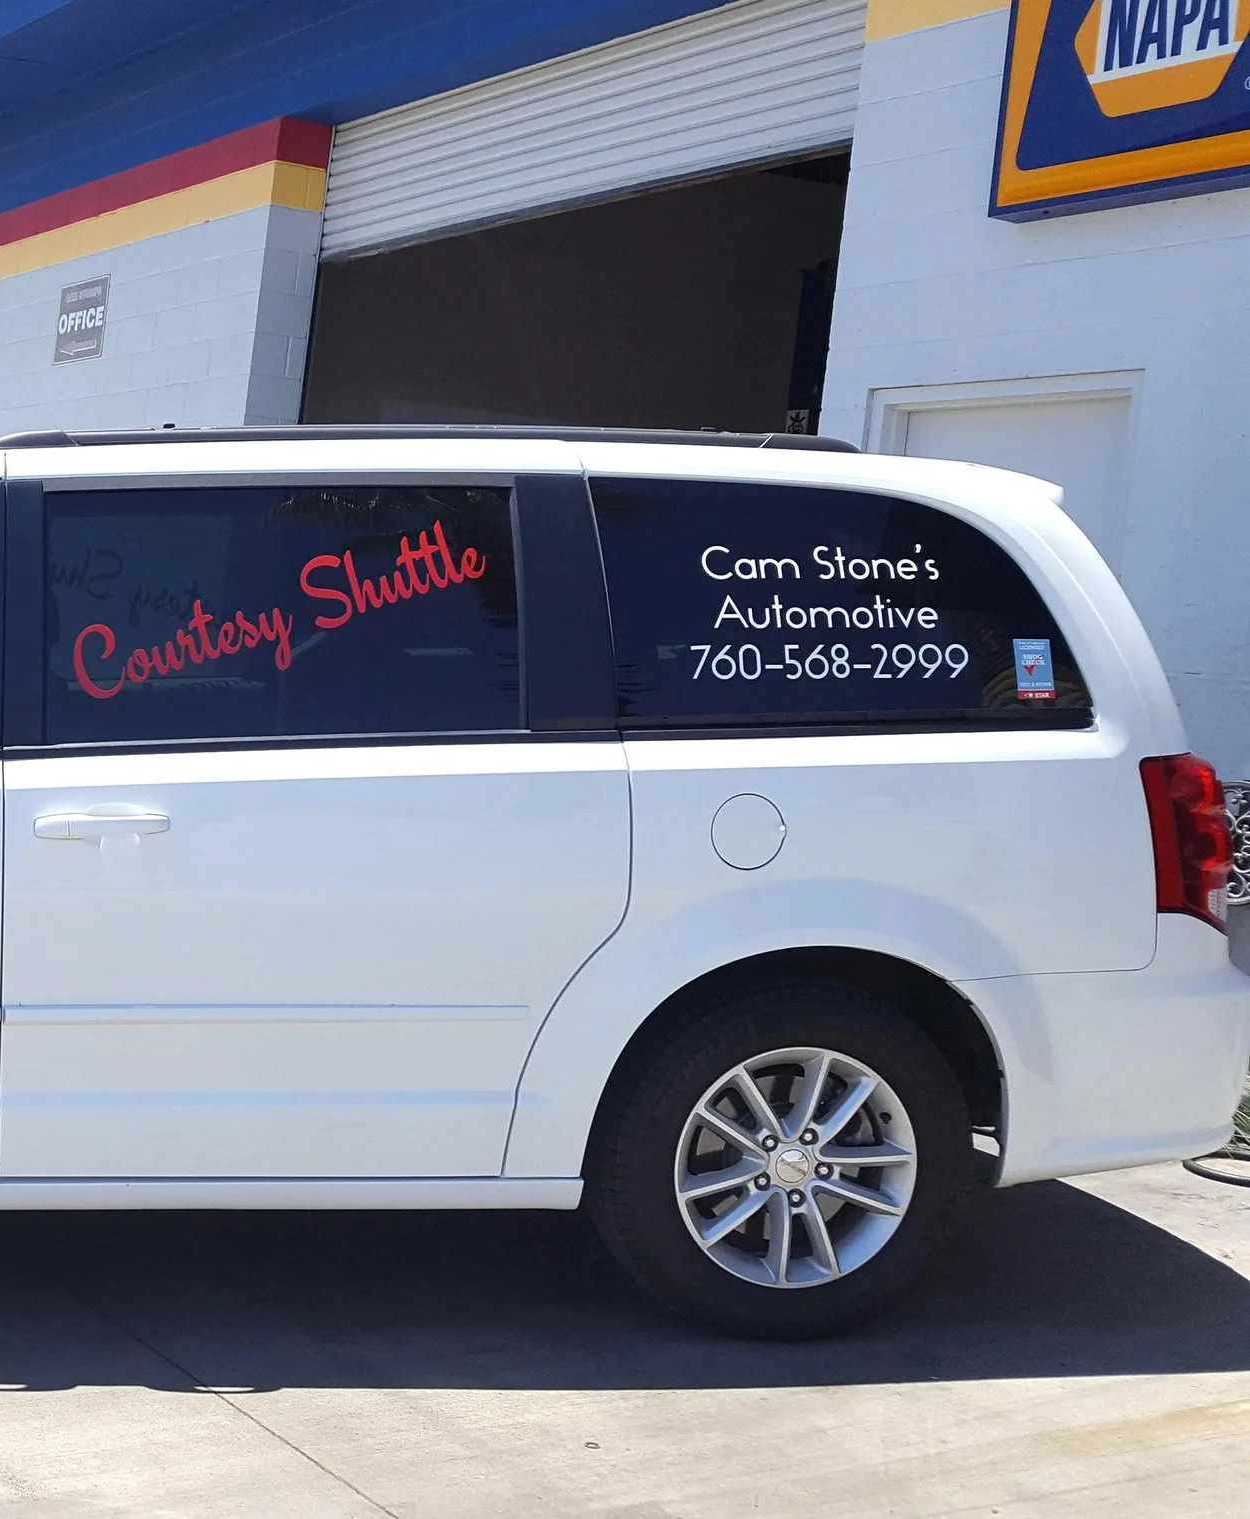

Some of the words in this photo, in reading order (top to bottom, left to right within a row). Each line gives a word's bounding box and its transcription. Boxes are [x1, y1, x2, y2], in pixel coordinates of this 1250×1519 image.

[1103, 0, 1229, 72] NAPA
[58, 305, 105, 335] OFFICE
[701, 545, 801, 580] Cam
[813, 543, 940, 580] Stone's
[73, 599, 293, 699] Courtesy
[300, 520, 486, 629] Shuttle
[713, 594, 939, 629] Automotive
[690, 643, 969, 680] 760-568-2999
